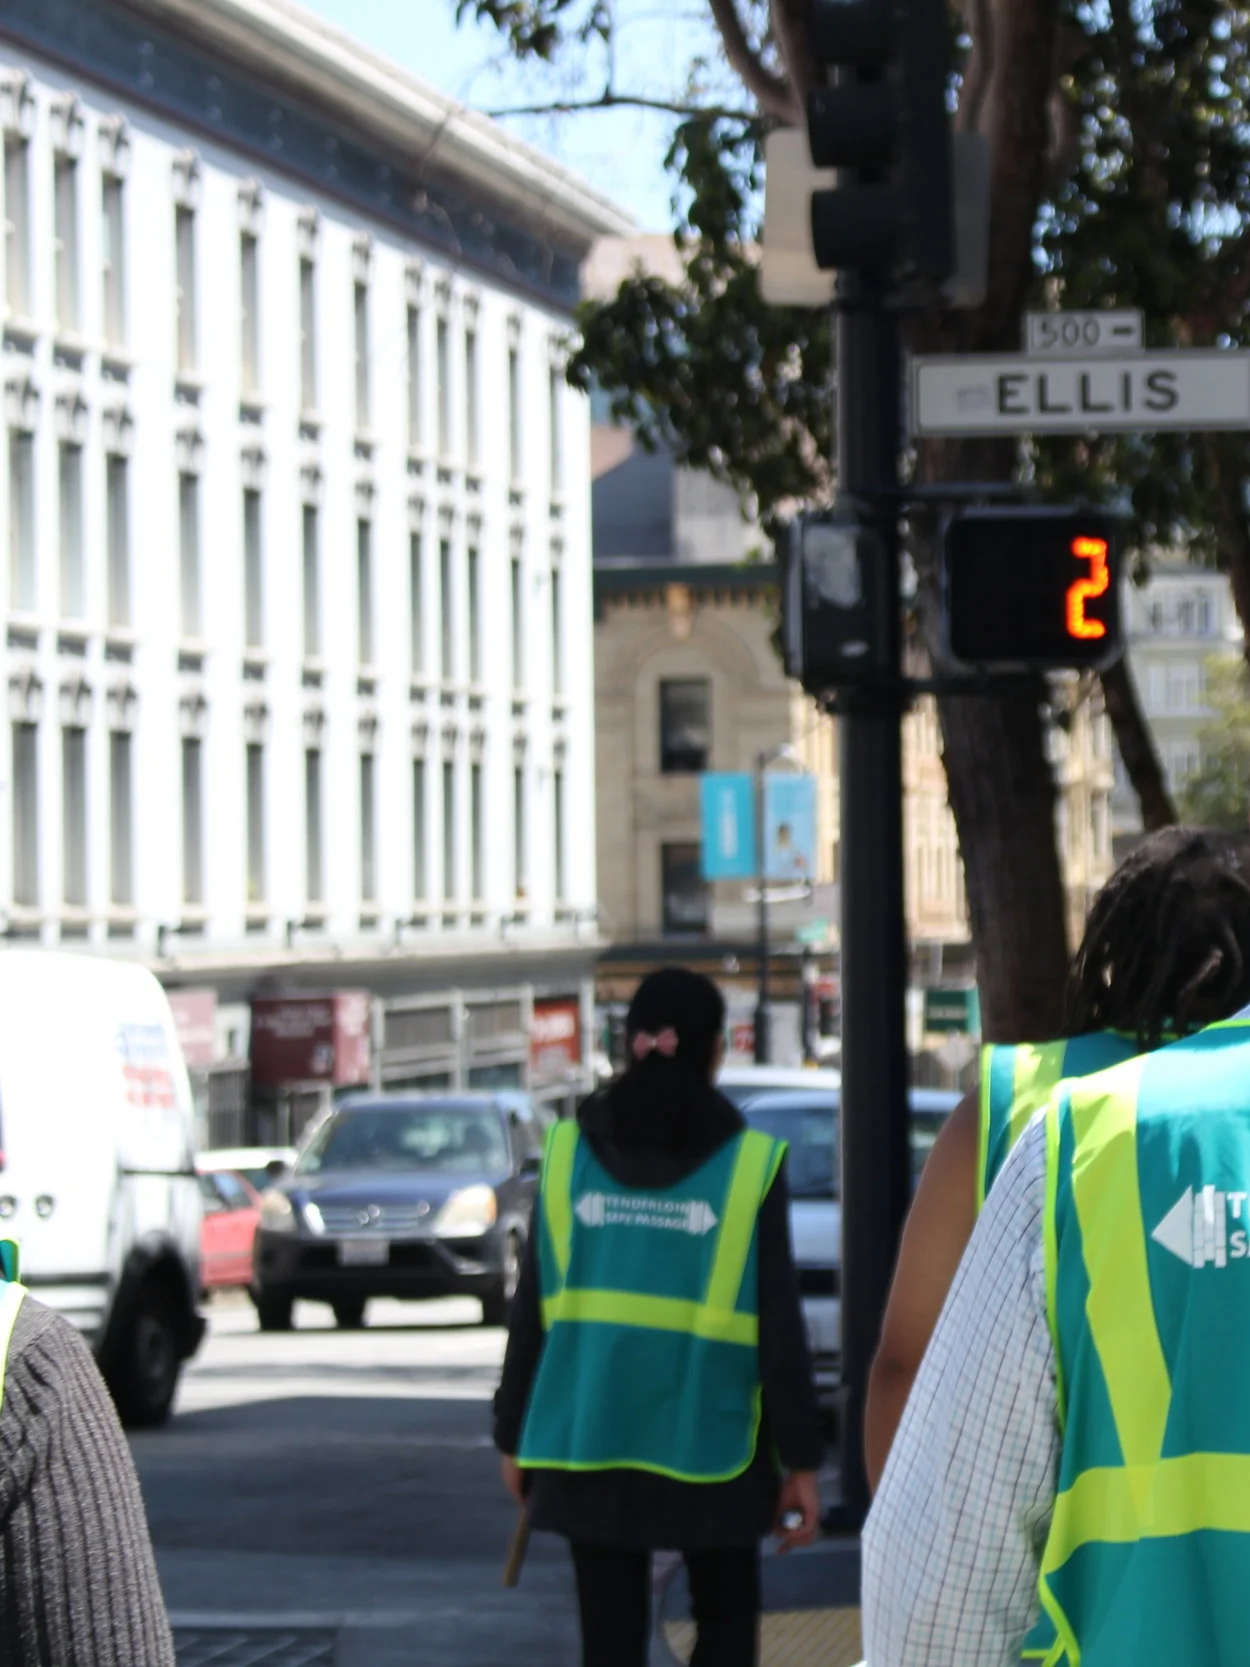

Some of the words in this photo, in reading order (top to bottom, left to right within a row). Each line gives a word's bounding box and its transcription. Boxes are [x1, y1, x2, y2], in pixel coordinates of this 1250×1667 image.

[1039, 316, 1100, 346] 500
[998, 370, 1179, 413] ELLIS
[1066, 536, 1109, 640] 2
[606, 1196, 689, 1214] TENDERLOIN
